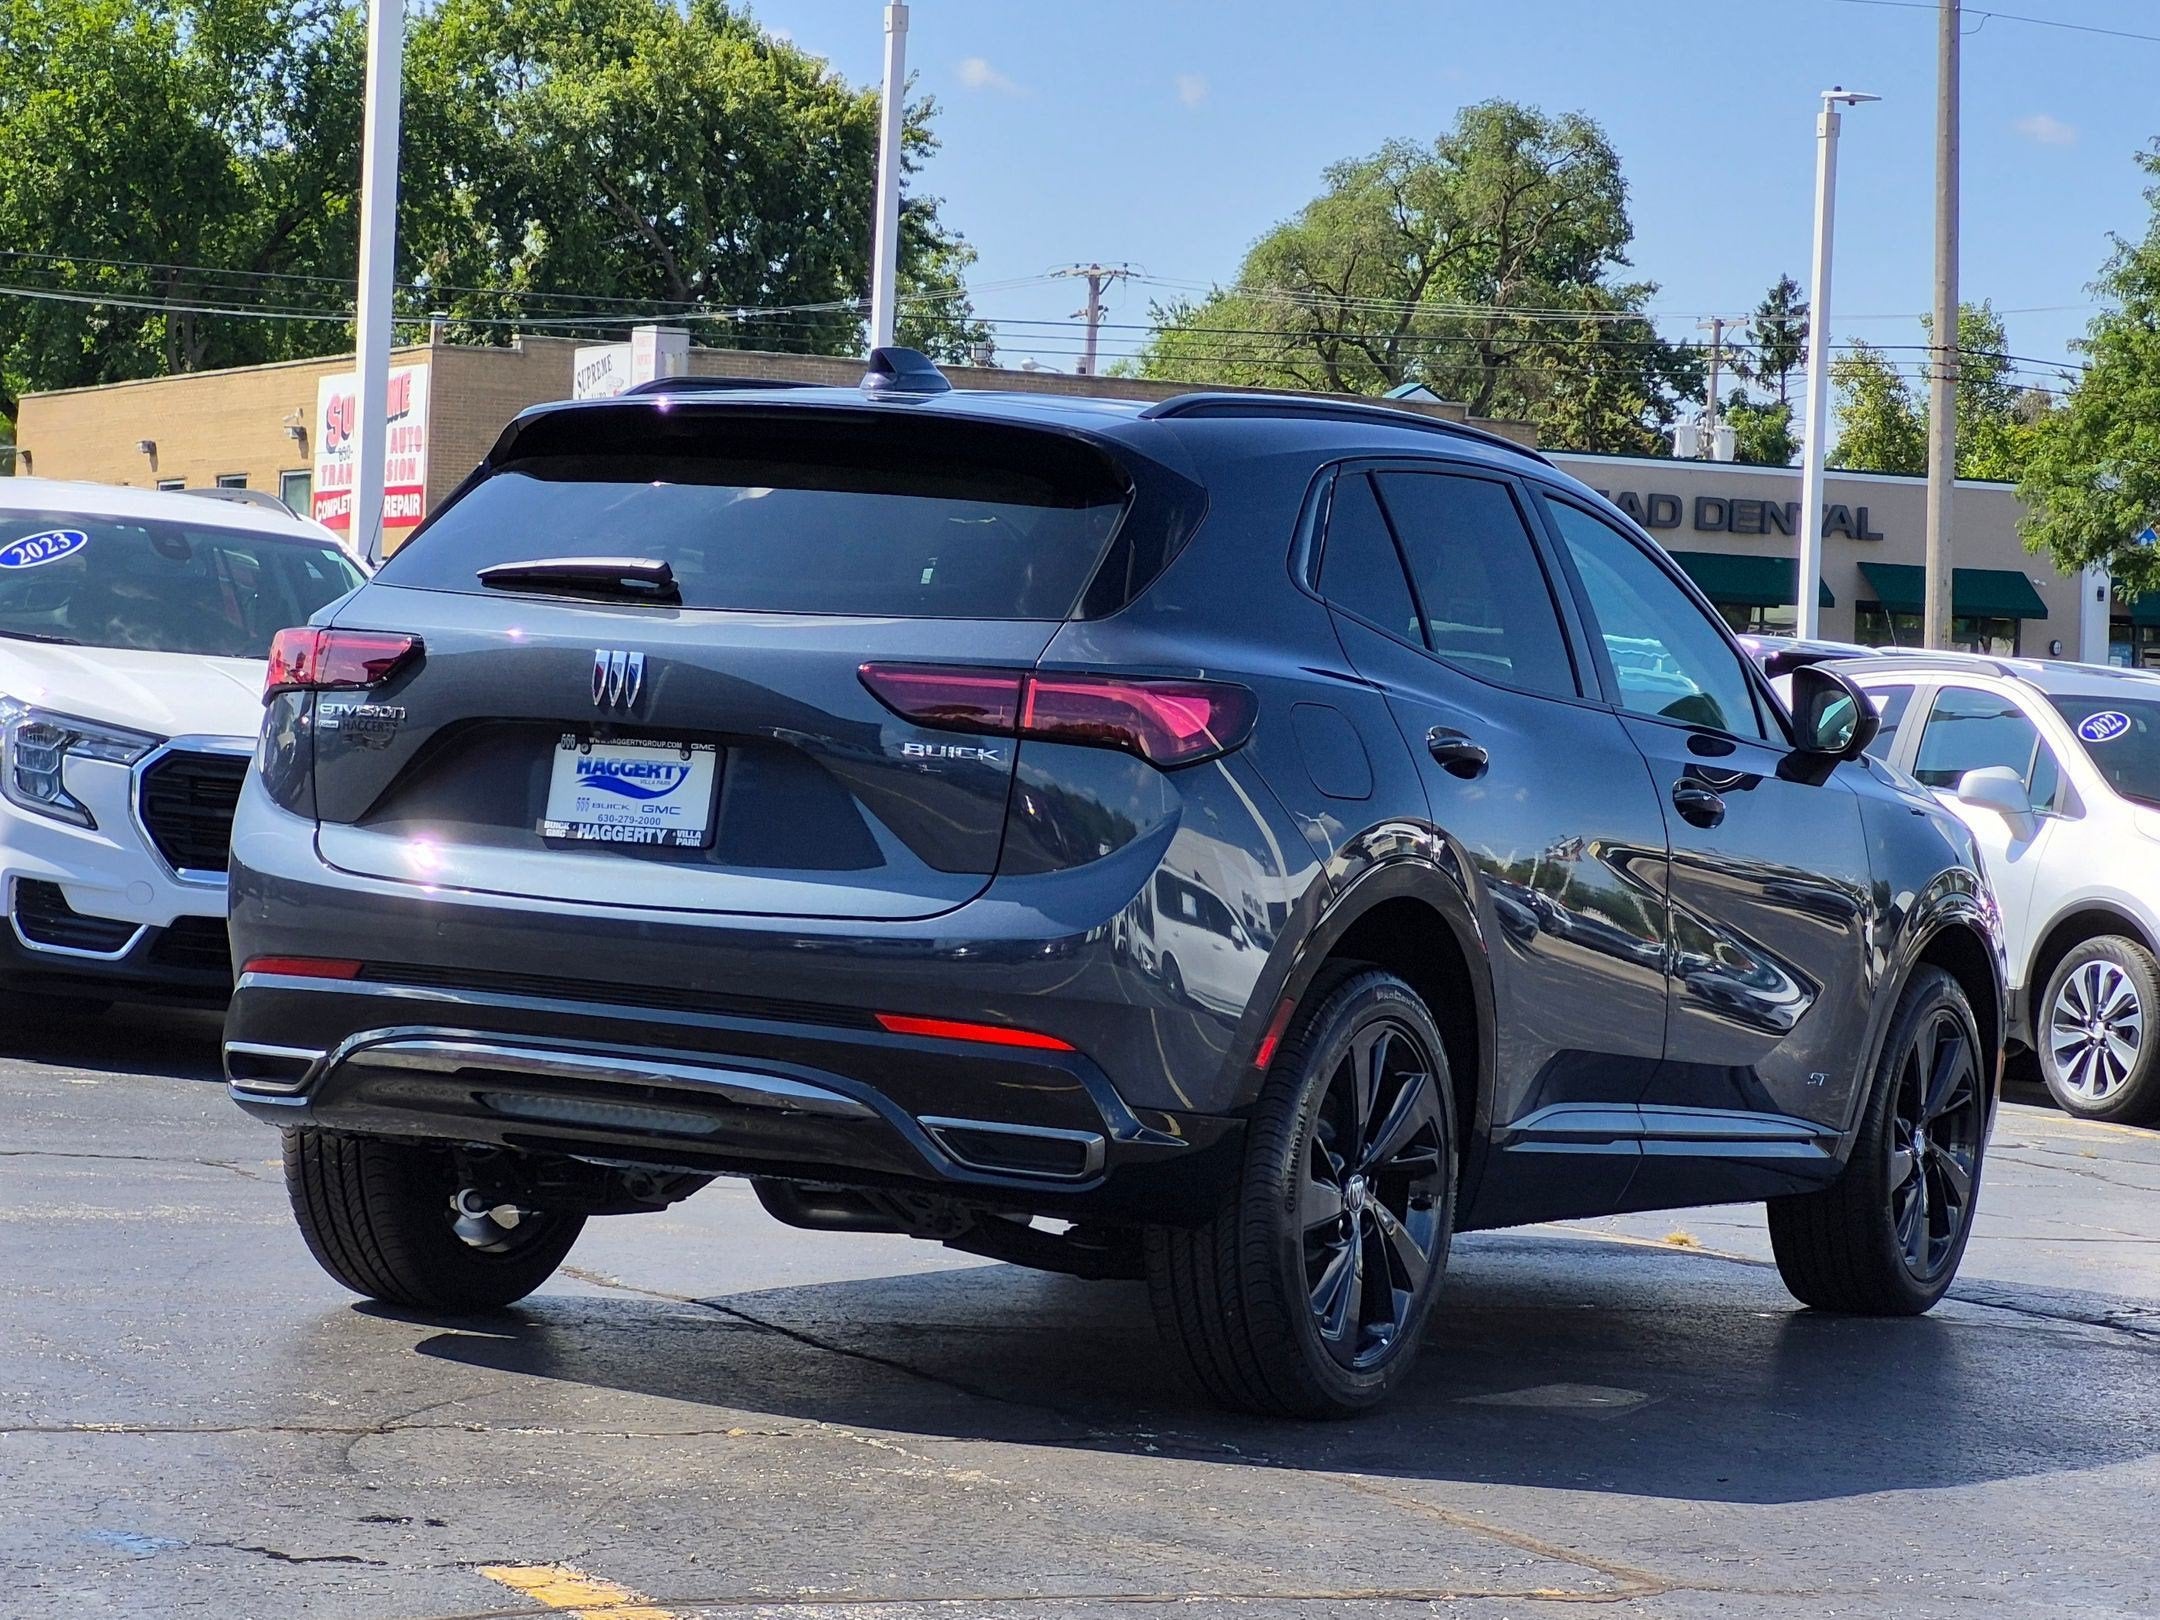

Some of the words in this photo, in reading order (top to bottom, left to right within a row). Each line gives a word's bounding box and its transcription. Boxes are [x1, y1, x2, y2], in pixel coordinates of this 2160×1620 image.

[577, 353, 613, 393] SUPREME
[326, 371, 412, 454] SUME
[390, 425, 422, 454] AUTO
[321, 458, 416, 487] TRANSION
[315, 494, 351, 522] COMPLET
[384, 493, 421, 518] REPAIR
[1694, 496, 1884, 541] DENAL
[11, 532, 71, 565] 2023
[320, 703, 406, 720] ENVISION
[2086, 713, 2123, 739] 2022
[690, 743, 716, 751] GMC
[901, 742, 1000, 762] BUICK
[576, 756, 694, 780] HAGGERTY
[592, 802, 630, 811] BUICK
[641, 804, 682, 816] GMC
[597, 813, 662, 826] 630-279-2000
[544, 820, 570, 830] BUICK
[546, 829, 566, 838] GMC
[577, 823, 667, 845] HAGGERTY
[676, 829, 702, 839] VILLA
[675, 837, 701, 847] PARK
